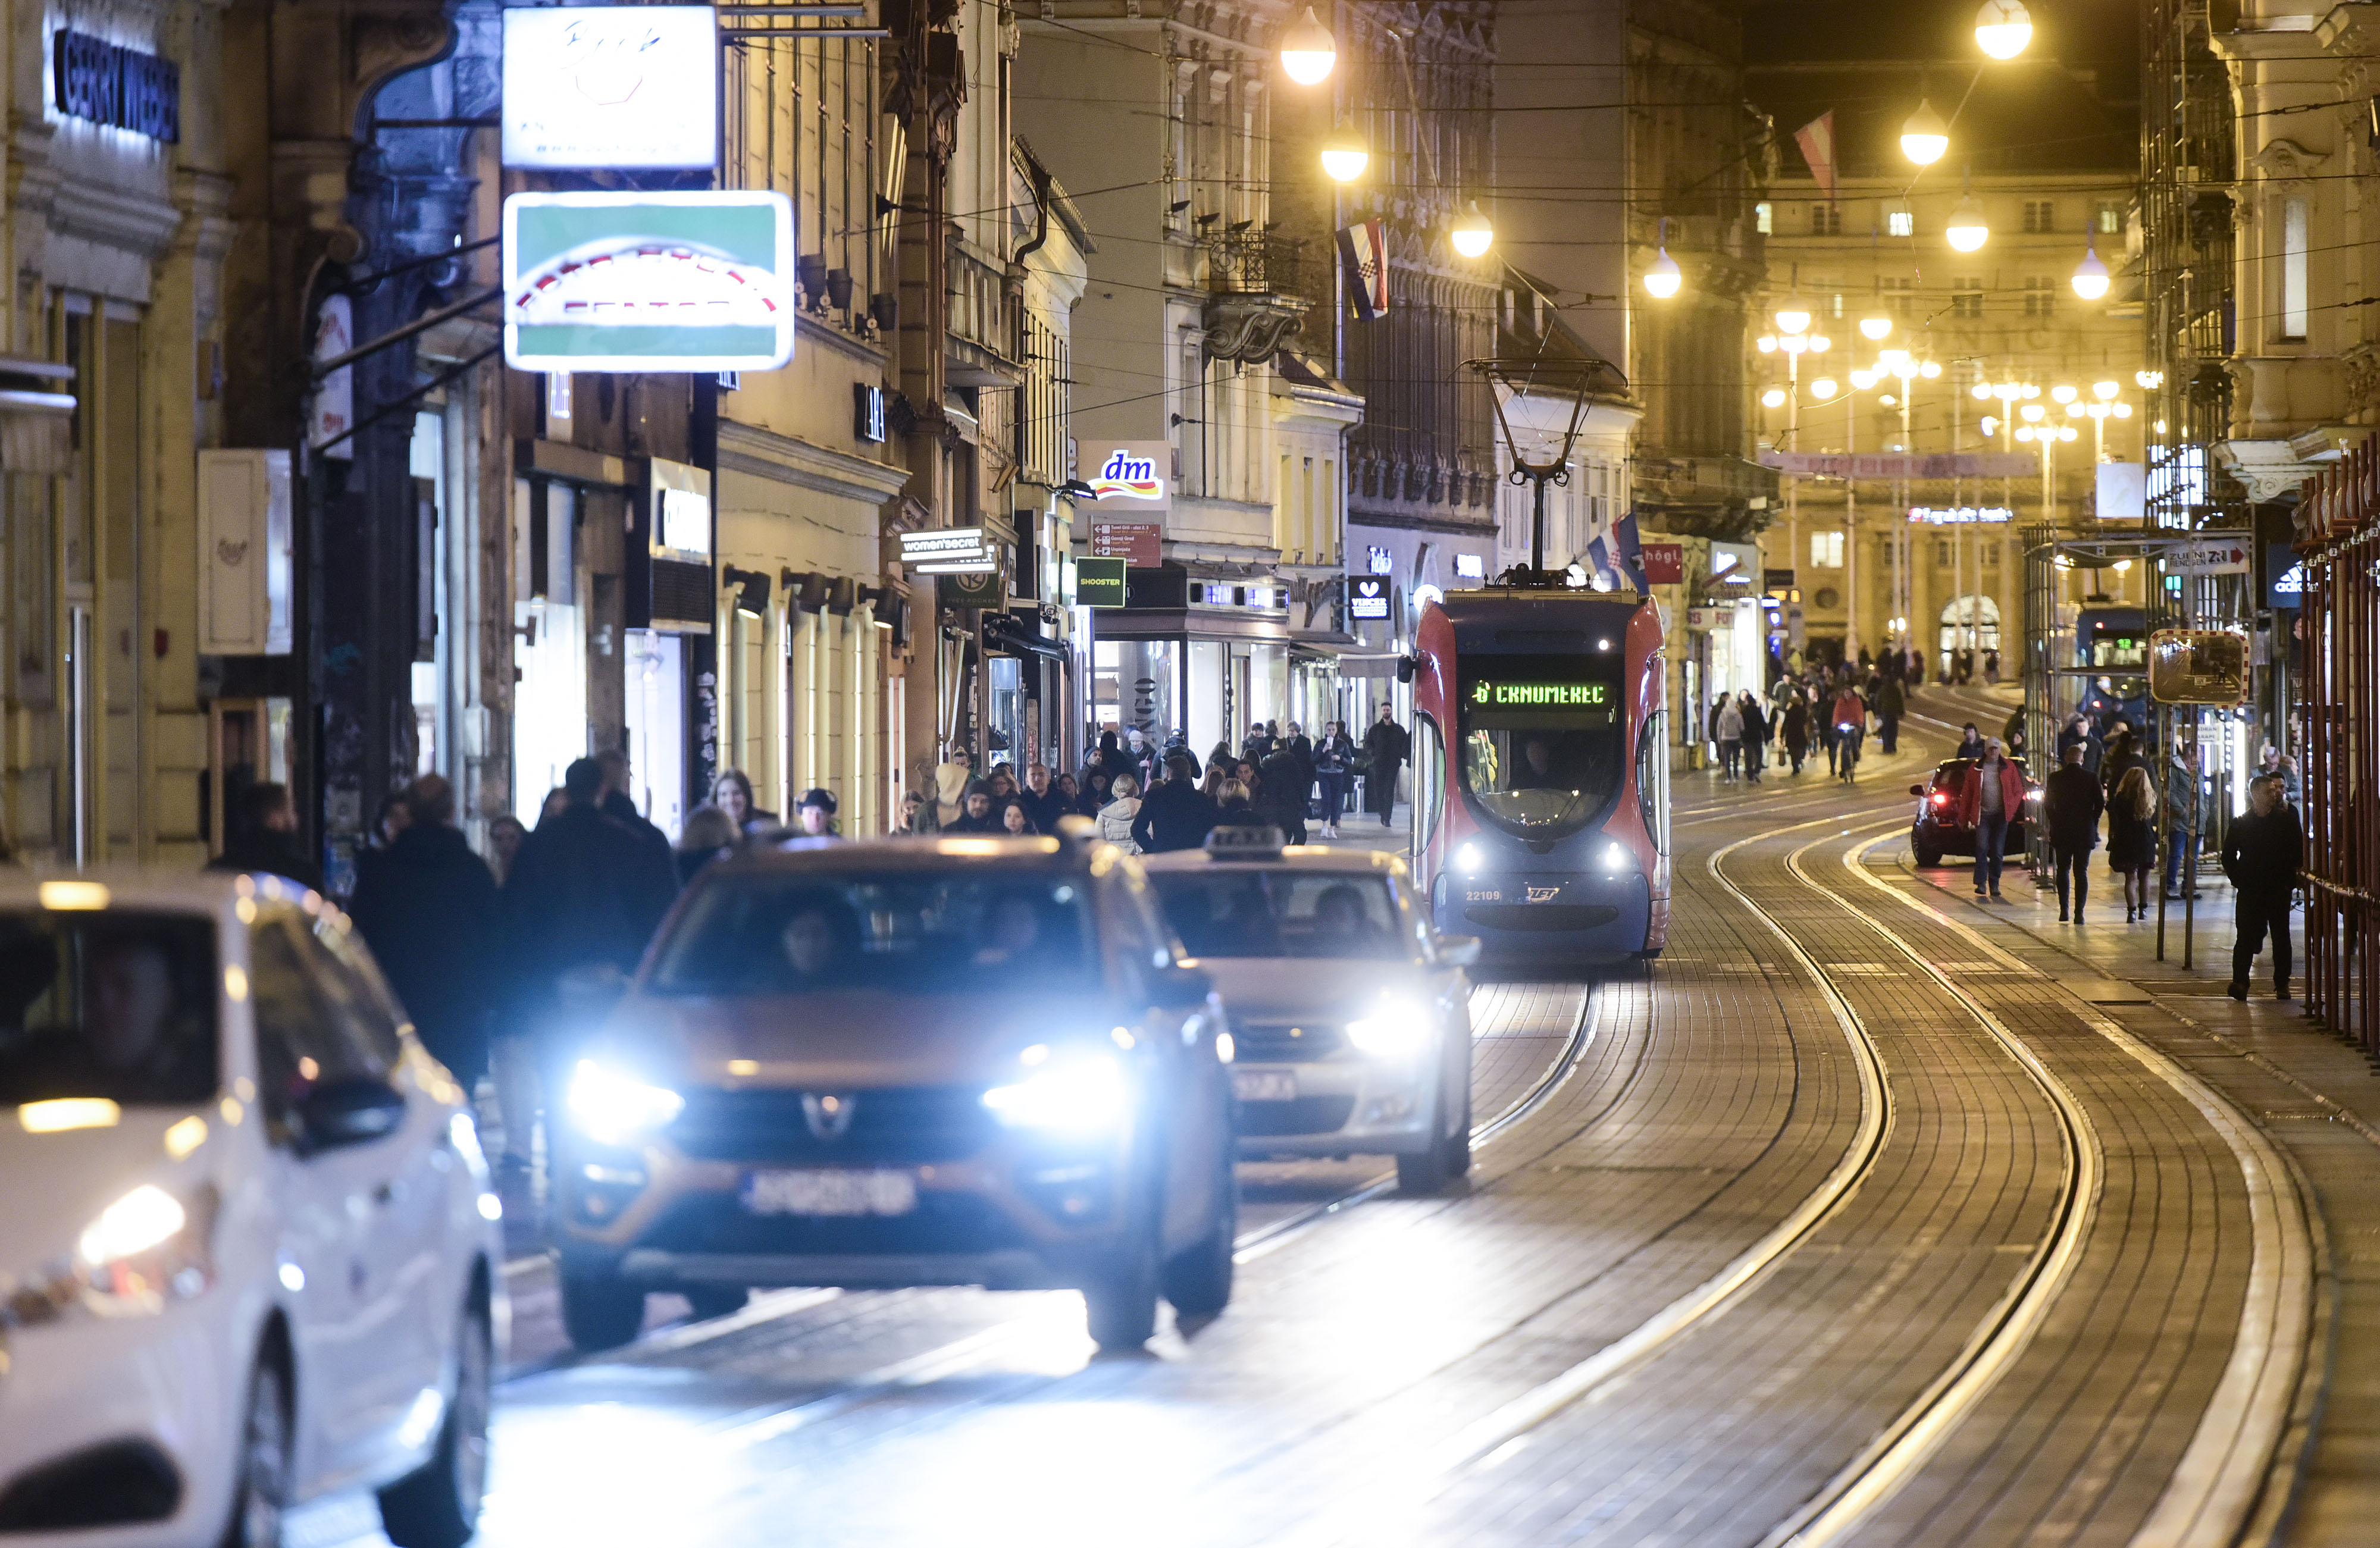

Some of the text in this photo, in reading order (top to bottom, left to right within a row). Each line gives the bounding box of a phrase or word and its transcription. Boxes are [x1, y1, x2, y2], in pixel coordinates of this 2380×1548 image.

[1105, 453, 1151, 480] dm
[904, 537, 979, 551] women'secret
[1466, 891, 1501, 900] 22109
